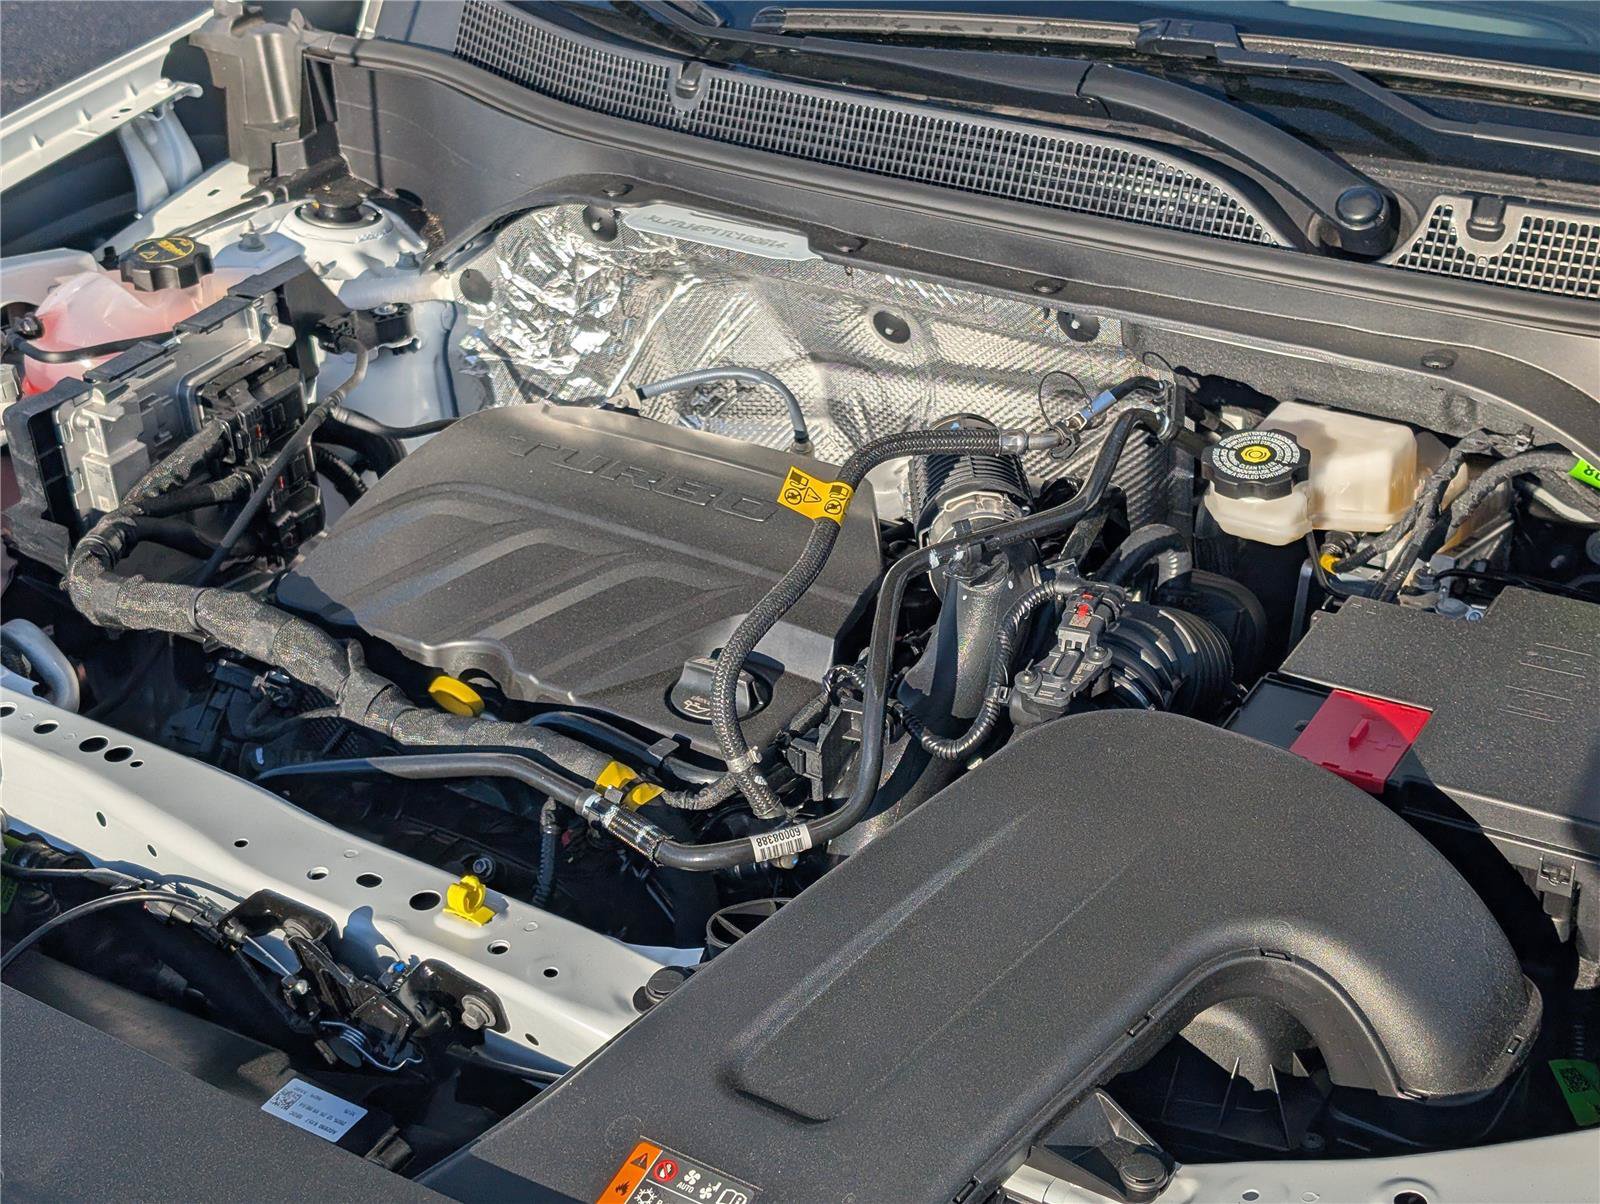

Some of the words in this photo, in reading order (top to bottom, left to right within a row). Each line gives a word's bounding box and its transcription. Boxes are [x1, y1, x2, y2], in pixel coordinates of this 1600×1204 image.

[509, 435, 779, 522] TURBO
[756, 827, 801, 847] 60008388
[676, 1181, 695, 1194] AUTO
